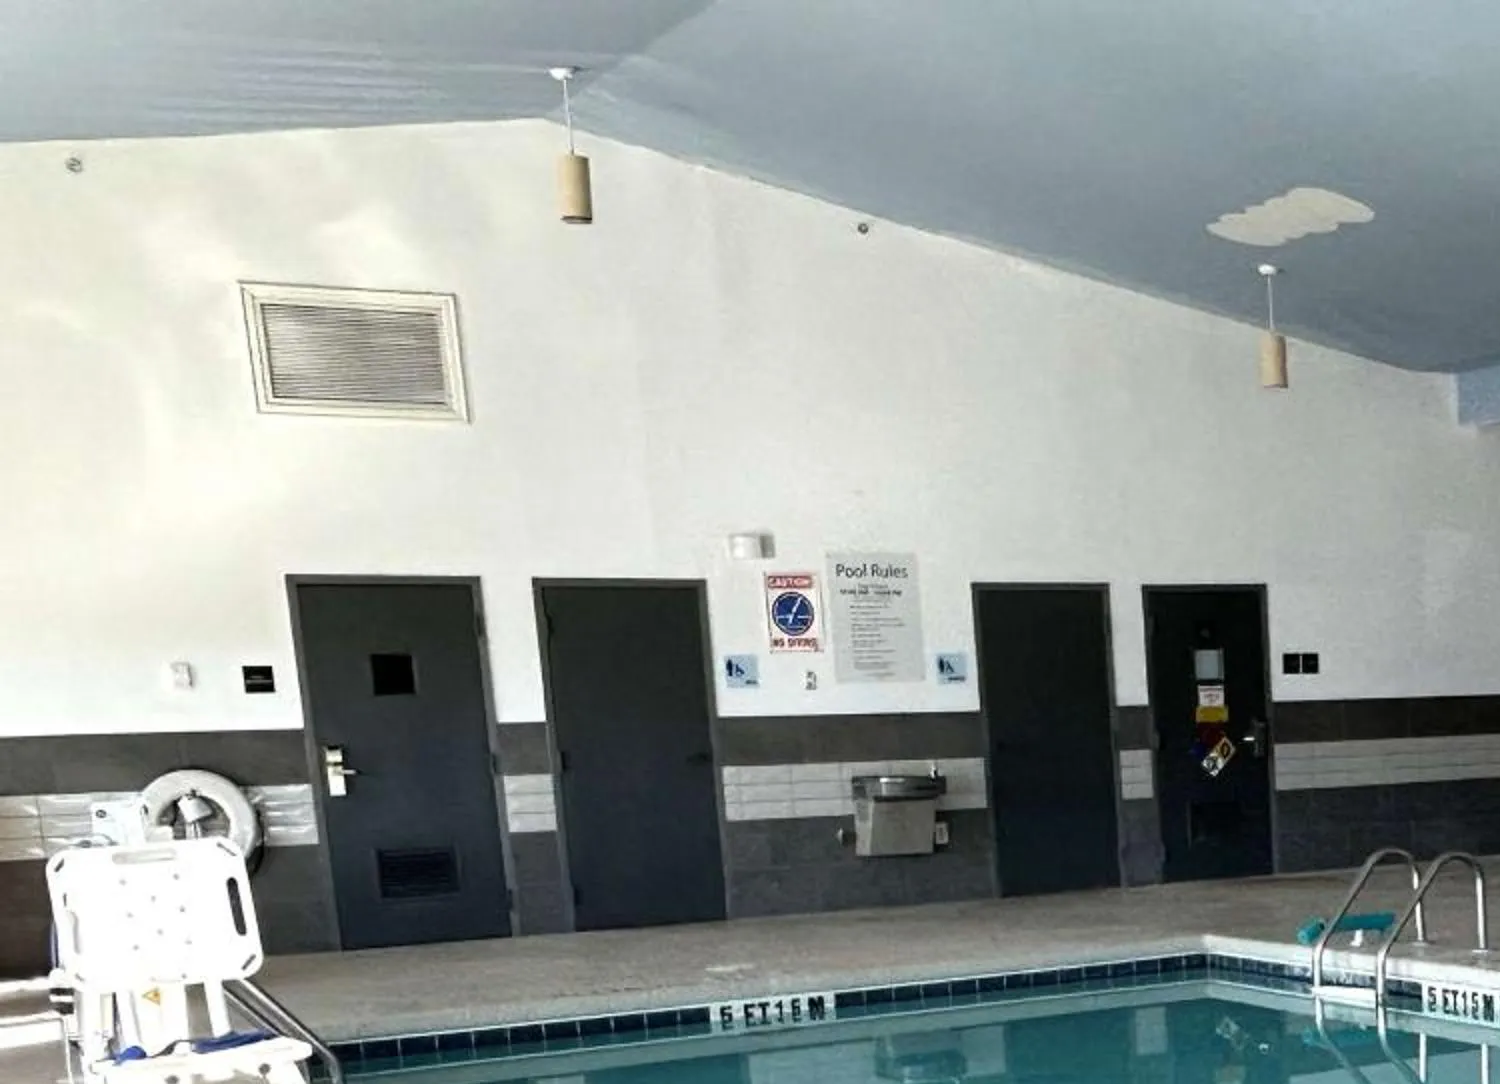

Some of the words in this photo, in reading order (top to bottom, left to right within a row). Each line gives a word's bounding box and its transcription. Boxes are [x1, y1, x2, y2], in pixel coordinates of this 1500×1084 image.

[835, 563, 867, 578] Pool
[871, 563, 909, 578] Rules
[768, 577, 811, 588] CAUTION
